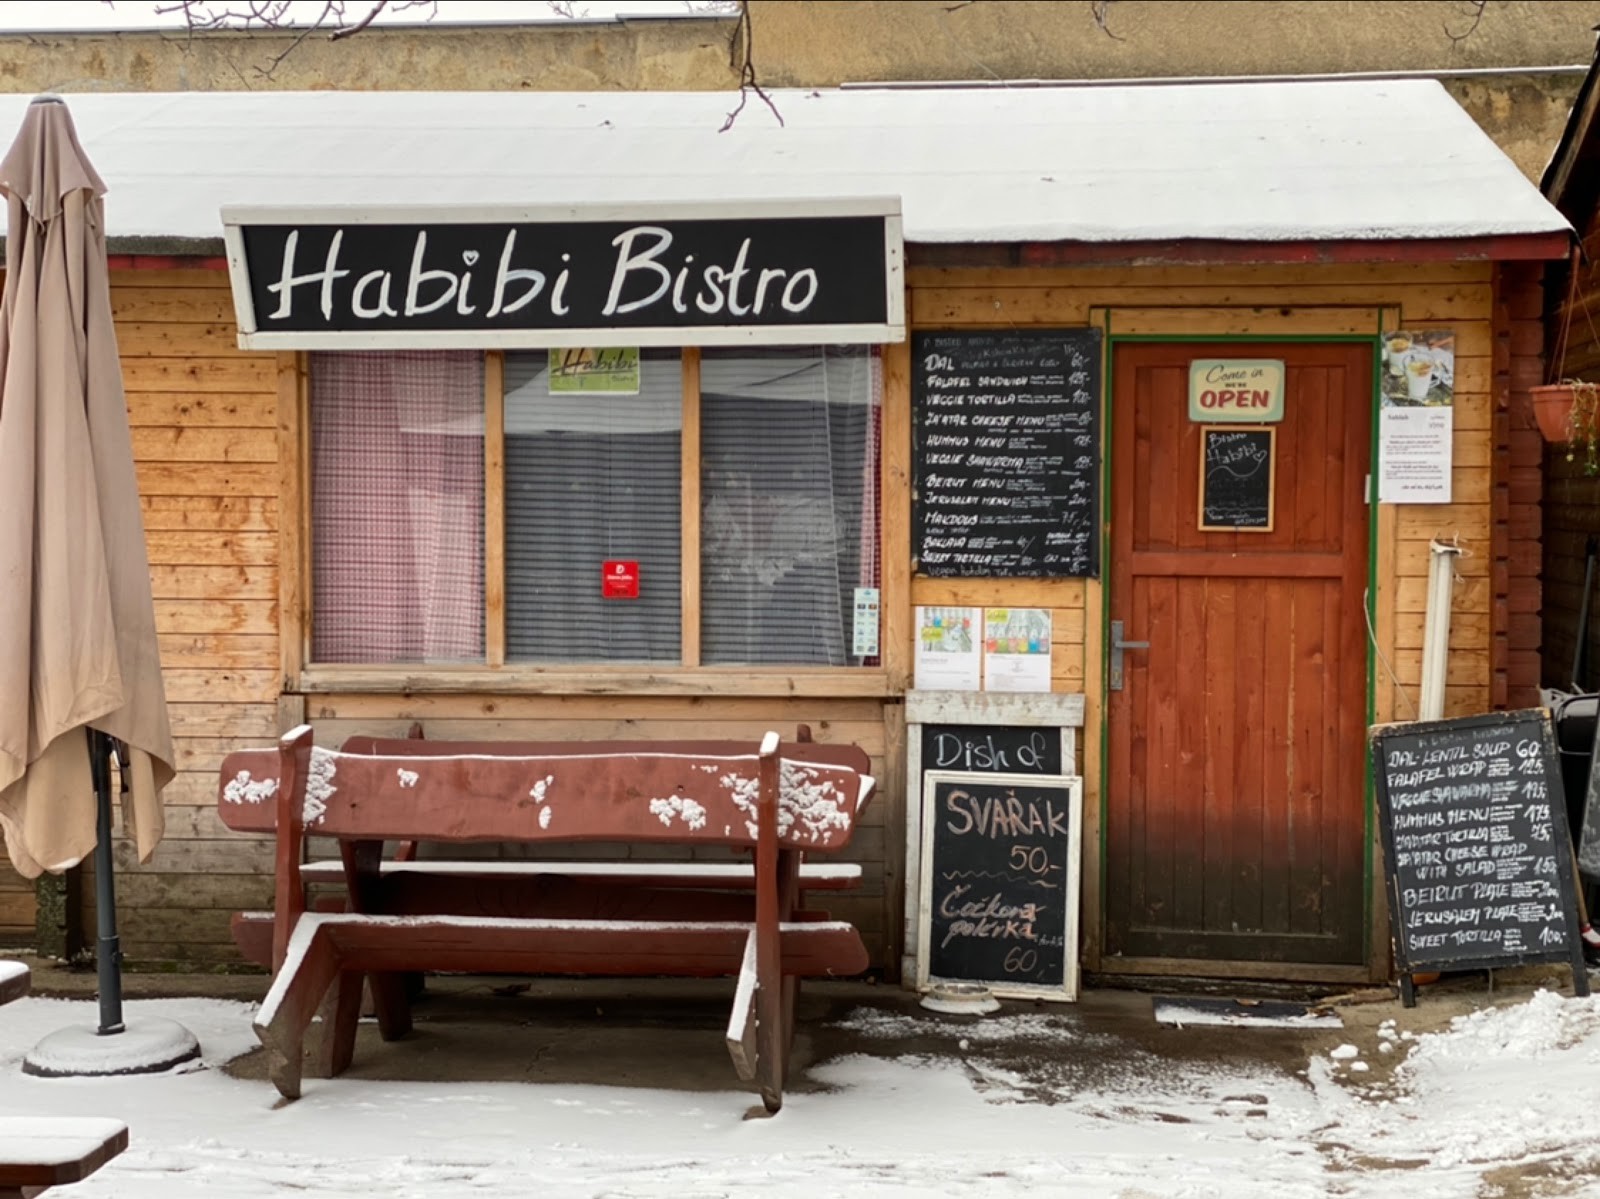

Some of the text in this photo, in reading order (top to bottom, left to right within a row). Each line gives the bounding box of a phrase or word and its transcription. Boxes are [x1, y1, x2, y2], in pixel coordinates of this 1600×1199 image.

[267, 226, 818, 320] Habibi Bistro
[552, 347, 637, 376] Habibi
[924, 353, 955, 371] DAL
[1206, 364, 1264, 384] Come in
[926, 394, 964, 405] VEGGIE
[967, 393, 1015, 405] TORTILLA
[1200, 390, 1269, 408] OPEN
[1207, 442, 1257, 464] Habibi
[972, 478, 1005, 488] MENU
[934, 733, 1046, 771] Dish of
[1422, 746, 1469, 766] LENTIL
[1472, 742, 1511, 759] SOUP
[1387, 767, 1445, 788] FALAFEL
[1447, 760, 1487, 778] WRAP
[1394, 811, 1445, 830] HUMMUS
[1447, 806, 1490, 825] MENU
[1444, 844, 1489, 862] CHEESE
[1490, 842, 1528, 859] WRAP
[1455, 860, 1496, 877] SALAD
[1403, 884, 1470, 908] BEIRUT
[1470, 881, 1510, 902] PLATE
[1407, 908, 1480, 928] JERUSALEM
[1483, 904, 1518, 922] PLATE
[1409, 932, 1449, 951] SWEET
[1450, 929, 1502, 946] TORTILLA
